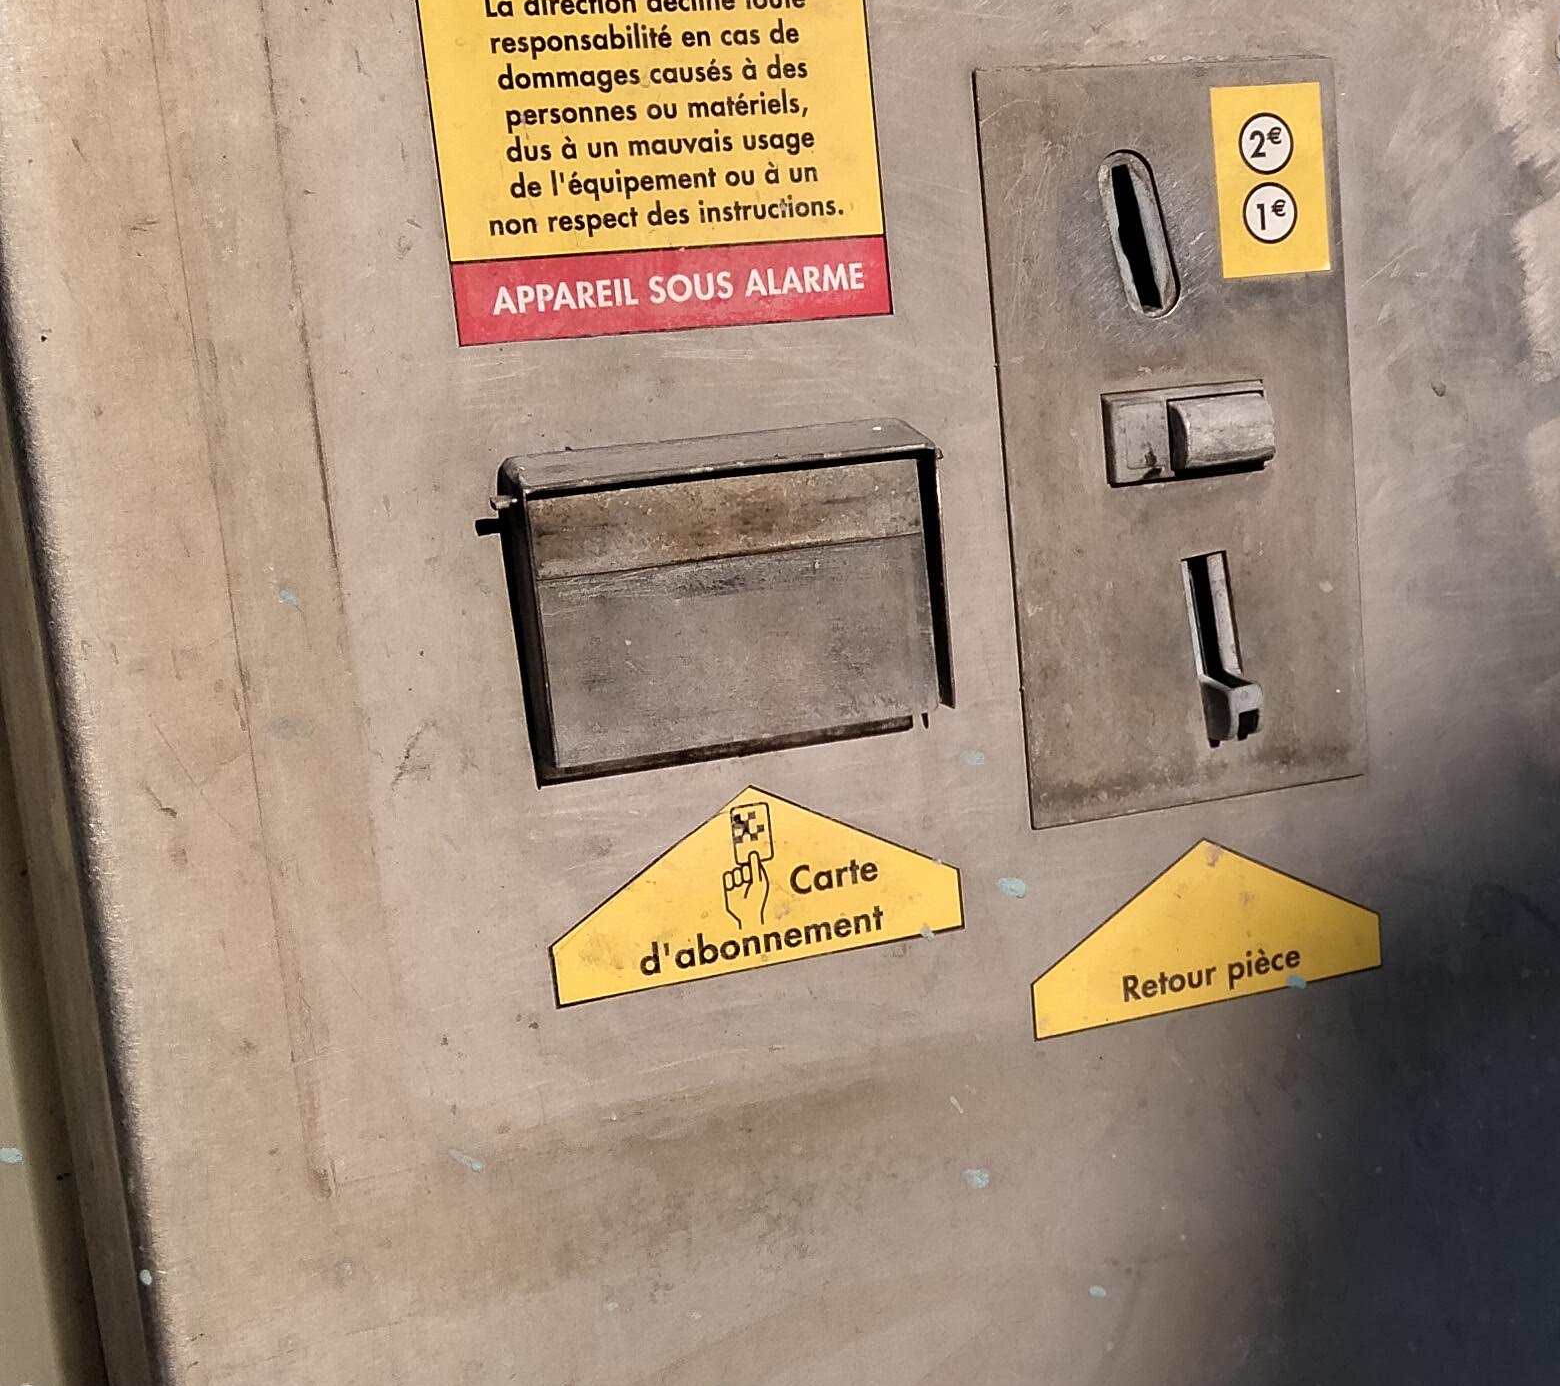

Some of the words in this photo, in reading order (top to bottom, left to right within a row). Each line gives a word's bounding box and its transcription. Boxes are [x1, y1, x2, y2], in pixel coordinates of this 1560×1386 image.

[491, 23, 672, 60] responsabilité
[682, 31, 710, 47] en
[721, 29, 760, 46] cas
[770, 18, 799, 44] de
[498, 63, 640, 93] dommages
[650, 59, 732, 84] causés
[742, 58, 757, 80] à
[767, 54, 807, 79] des
[506, 105, 637, 134] personnes
[647, 103, 677, 119] ou
[688, 88, 807, 118] matériels,
[507, 136, 551, 162] dus
[562, 136, 577, 159] à
[588, 141, 618, 158] un
[628, 129, 733, 156] mauvais
[743, 132, 814, 155] usage
[510, 172, 541, 198] de
[551, 168, 716, 201] l'équipement
[726, 170, 754, 186] ou
[765, 162, 779, 184] à
[789, 167, 818, 183] un
[490, 218, 537, 236] non
[548, 207, 638, 237] respect
[647, 200, 689, 226] des
[699, 195, 843, 223] instructions.
[494, 278, 639, 315] APPAREIL
[649, 271, 733, 304] SOUS
[745, 263, 864, 296] ALARME
[790, 860, 877, 894] Carte
[640, 906, 883, 975] d'abonnement
[1123, 967, 1216, 1002] Retour
[1228, 949, 1300, 990] pièce
